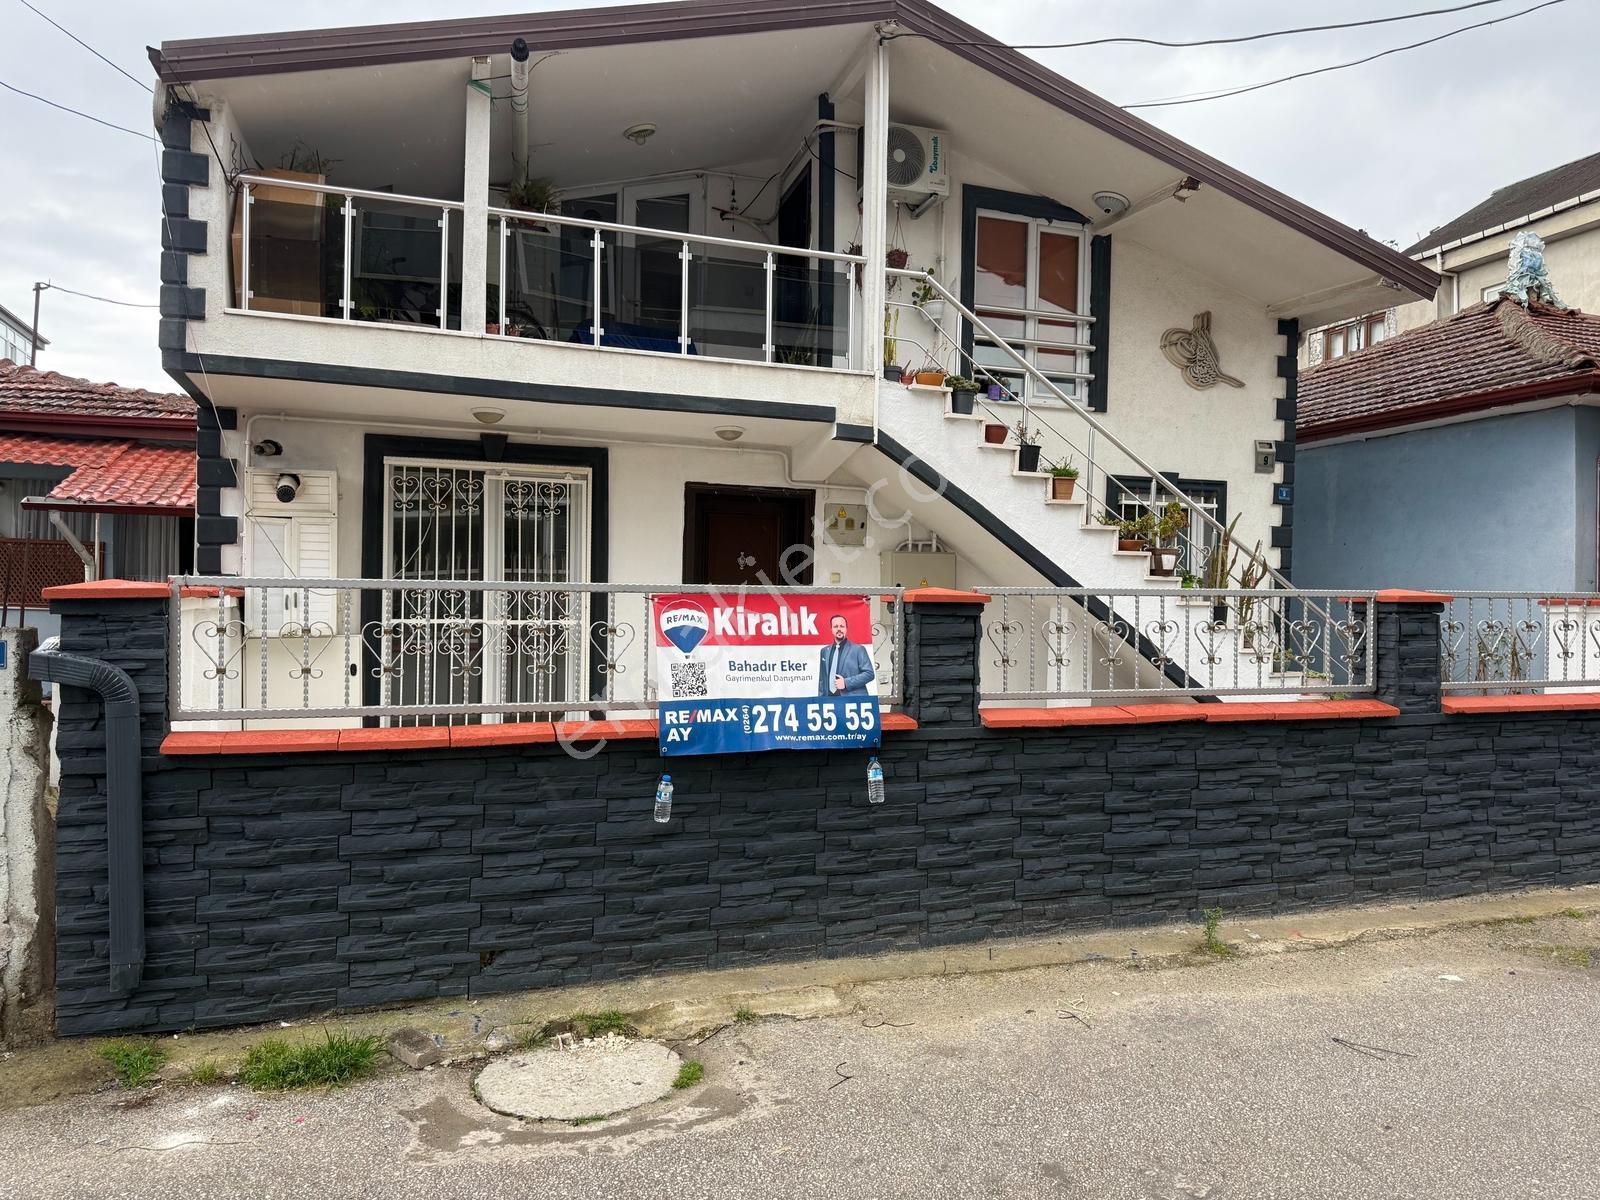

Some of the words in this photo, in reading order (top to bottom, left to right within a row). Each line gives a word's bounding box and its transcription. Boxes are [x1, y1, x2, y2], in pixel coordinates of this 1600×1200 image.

[930, 135, 939, 168] baymak
[1263, 456, 1268, 465] 9
[666, 614, 704, 624] RE/MAX
[713, 606, 819, 636] Kiralık
[729, 660, 776, 672] Bahadır
[781, 660, 808, 671] Eker
[726, 674, 772, 683] Gayrimenkul
[774, 674, 813, 683] Danışmanı
[665, 708, 739, 725] RE/MAX
[742, 705, 752, 734] (0264)
[752, 704, 799, 734] 274
[807, 703, 837, 731] 55
[846, 703, 875, 731] 55
[667, 727, 692, 742] AY
[775, 733, 867, 742] www.remax.com.tr/ay
